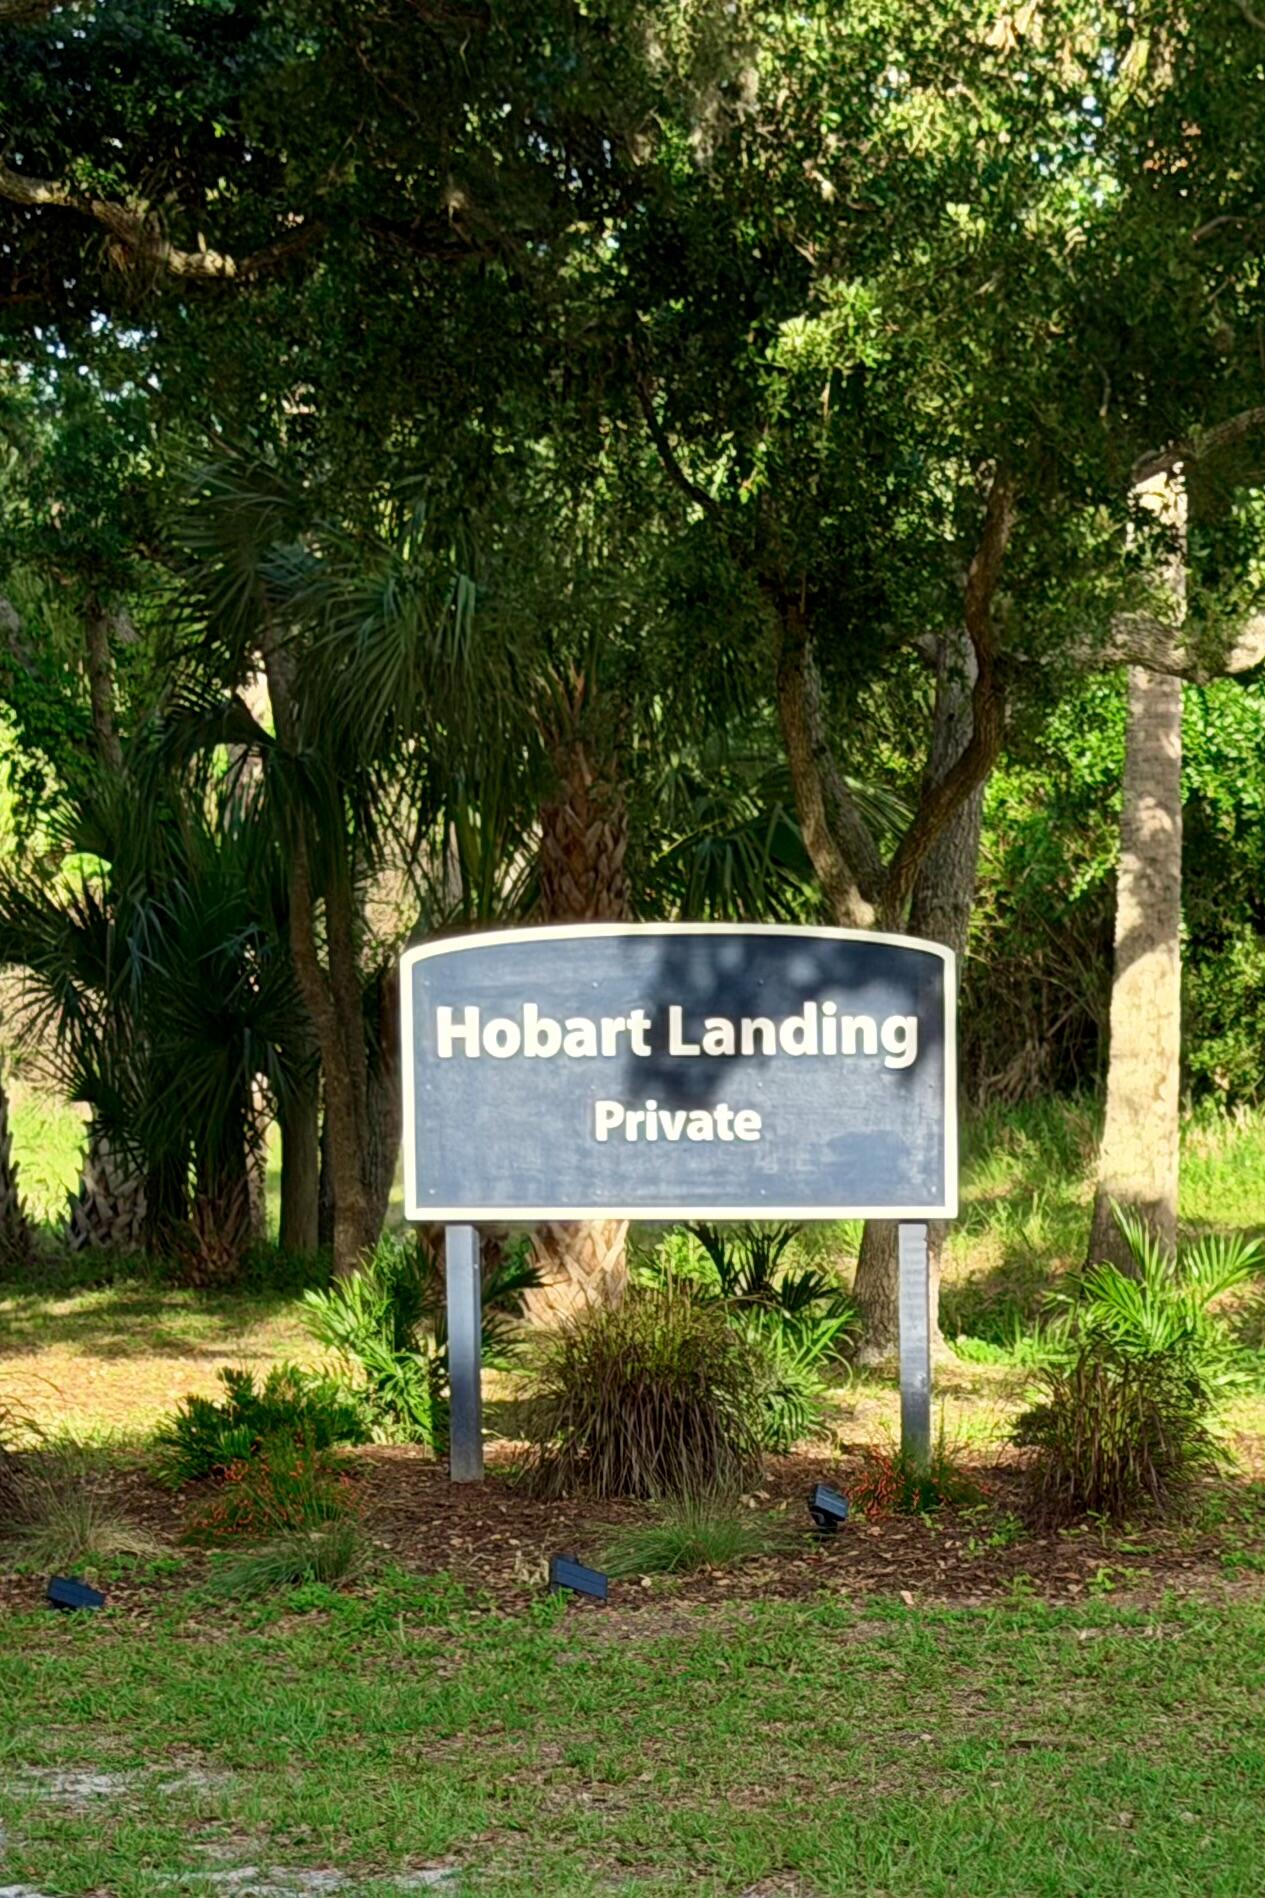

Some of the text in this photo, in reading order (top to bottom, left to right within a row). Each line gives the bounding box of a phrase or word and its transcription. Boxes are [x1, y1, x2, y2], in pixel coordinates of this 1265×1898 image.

[436, 1001, 919, 1069] Hobart Landing
[594, 1099, 762, 1142] Private
